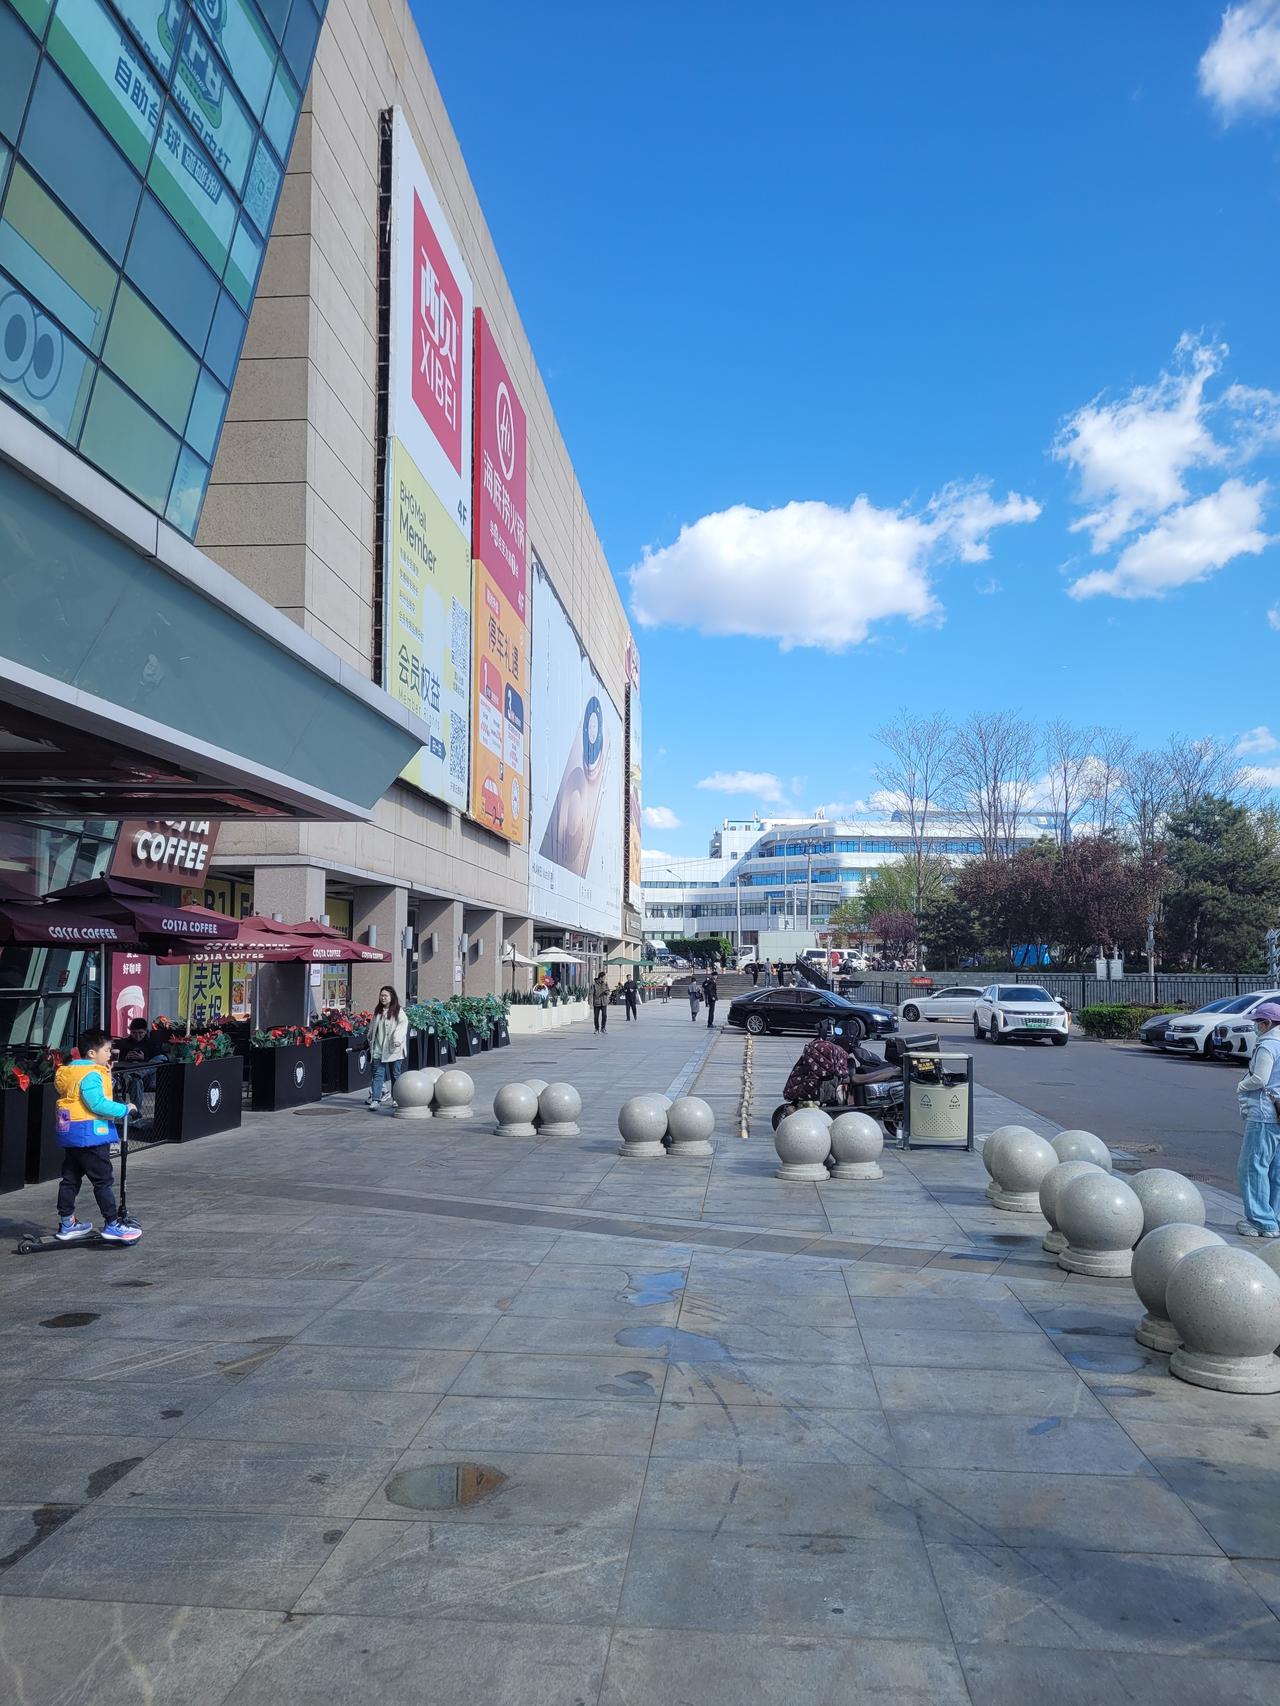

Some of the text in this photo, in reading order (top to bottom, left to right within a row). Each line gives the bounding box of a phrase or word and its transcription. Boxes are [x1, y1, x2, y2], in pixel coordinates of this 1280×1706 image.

[420, 328, 456, 432] XIBEI
[457, 499, 468, 526] 4F
[399, 505, 437, 575] Member
[398, 643, 441, 714] 会员权益
[136, 830, 208, 870] COFFEE
[48, 926, 118, 940] COSTA COFFEE
[162, 918, 218, 934] COSTA COFFEE
[312, 949, 341, 958] COSTA COFFEE
[122, 962, 142, 975] 好咖啡
